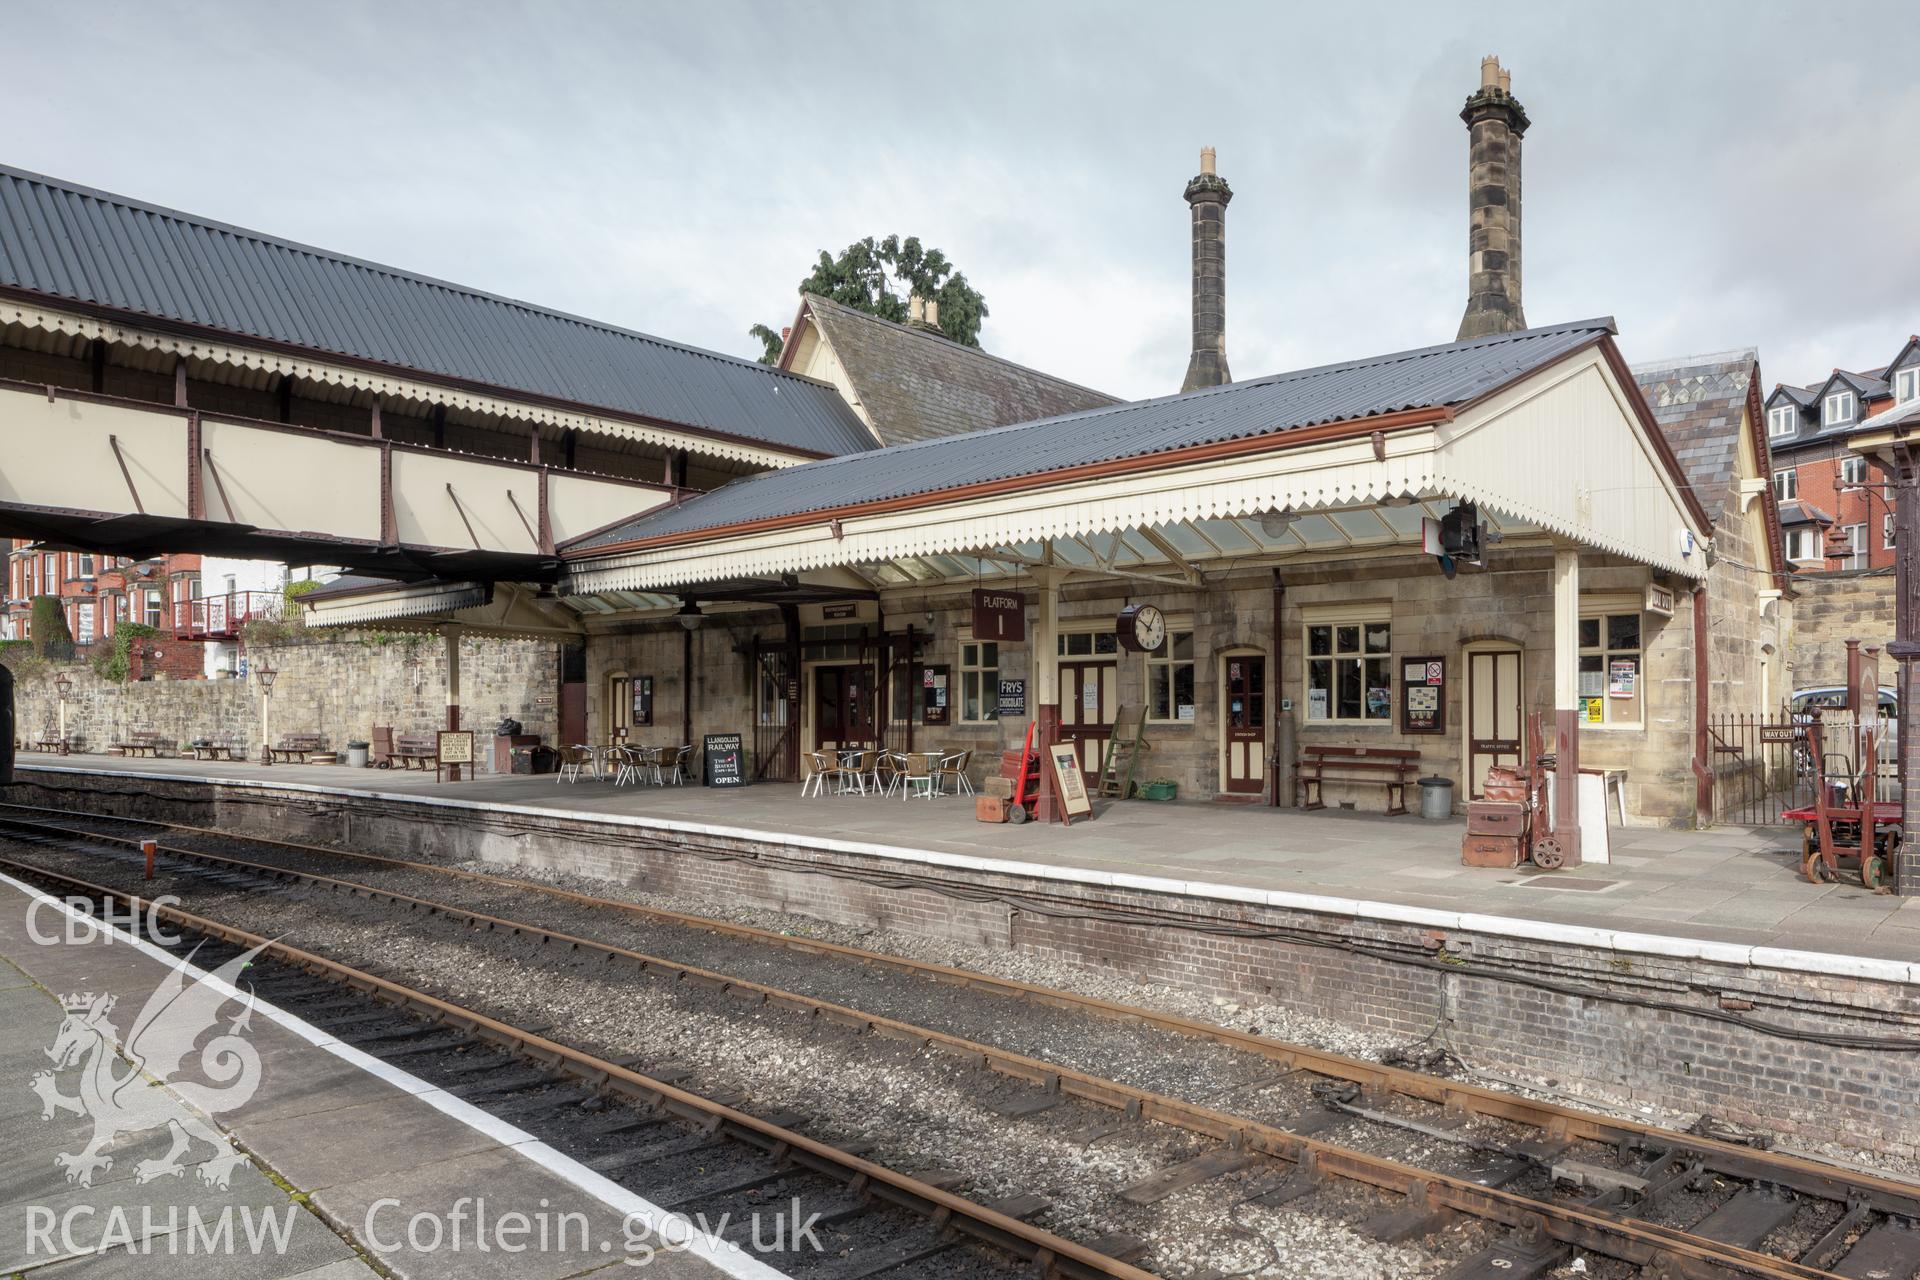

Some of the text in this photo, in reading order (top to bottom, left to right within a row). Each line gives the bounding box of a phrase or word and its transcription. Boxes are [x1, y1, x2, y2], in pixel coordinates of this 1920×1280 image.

[983, 596, 1018, 609] PLATFORM
[1001, 681, 1023, 693] FRY'S
[999, 697, 1024, 708] CHOCOLATE
[707, 736, 739, 744] LLANGOLLEN
[708, 743, 740, 752] RAILWAY
